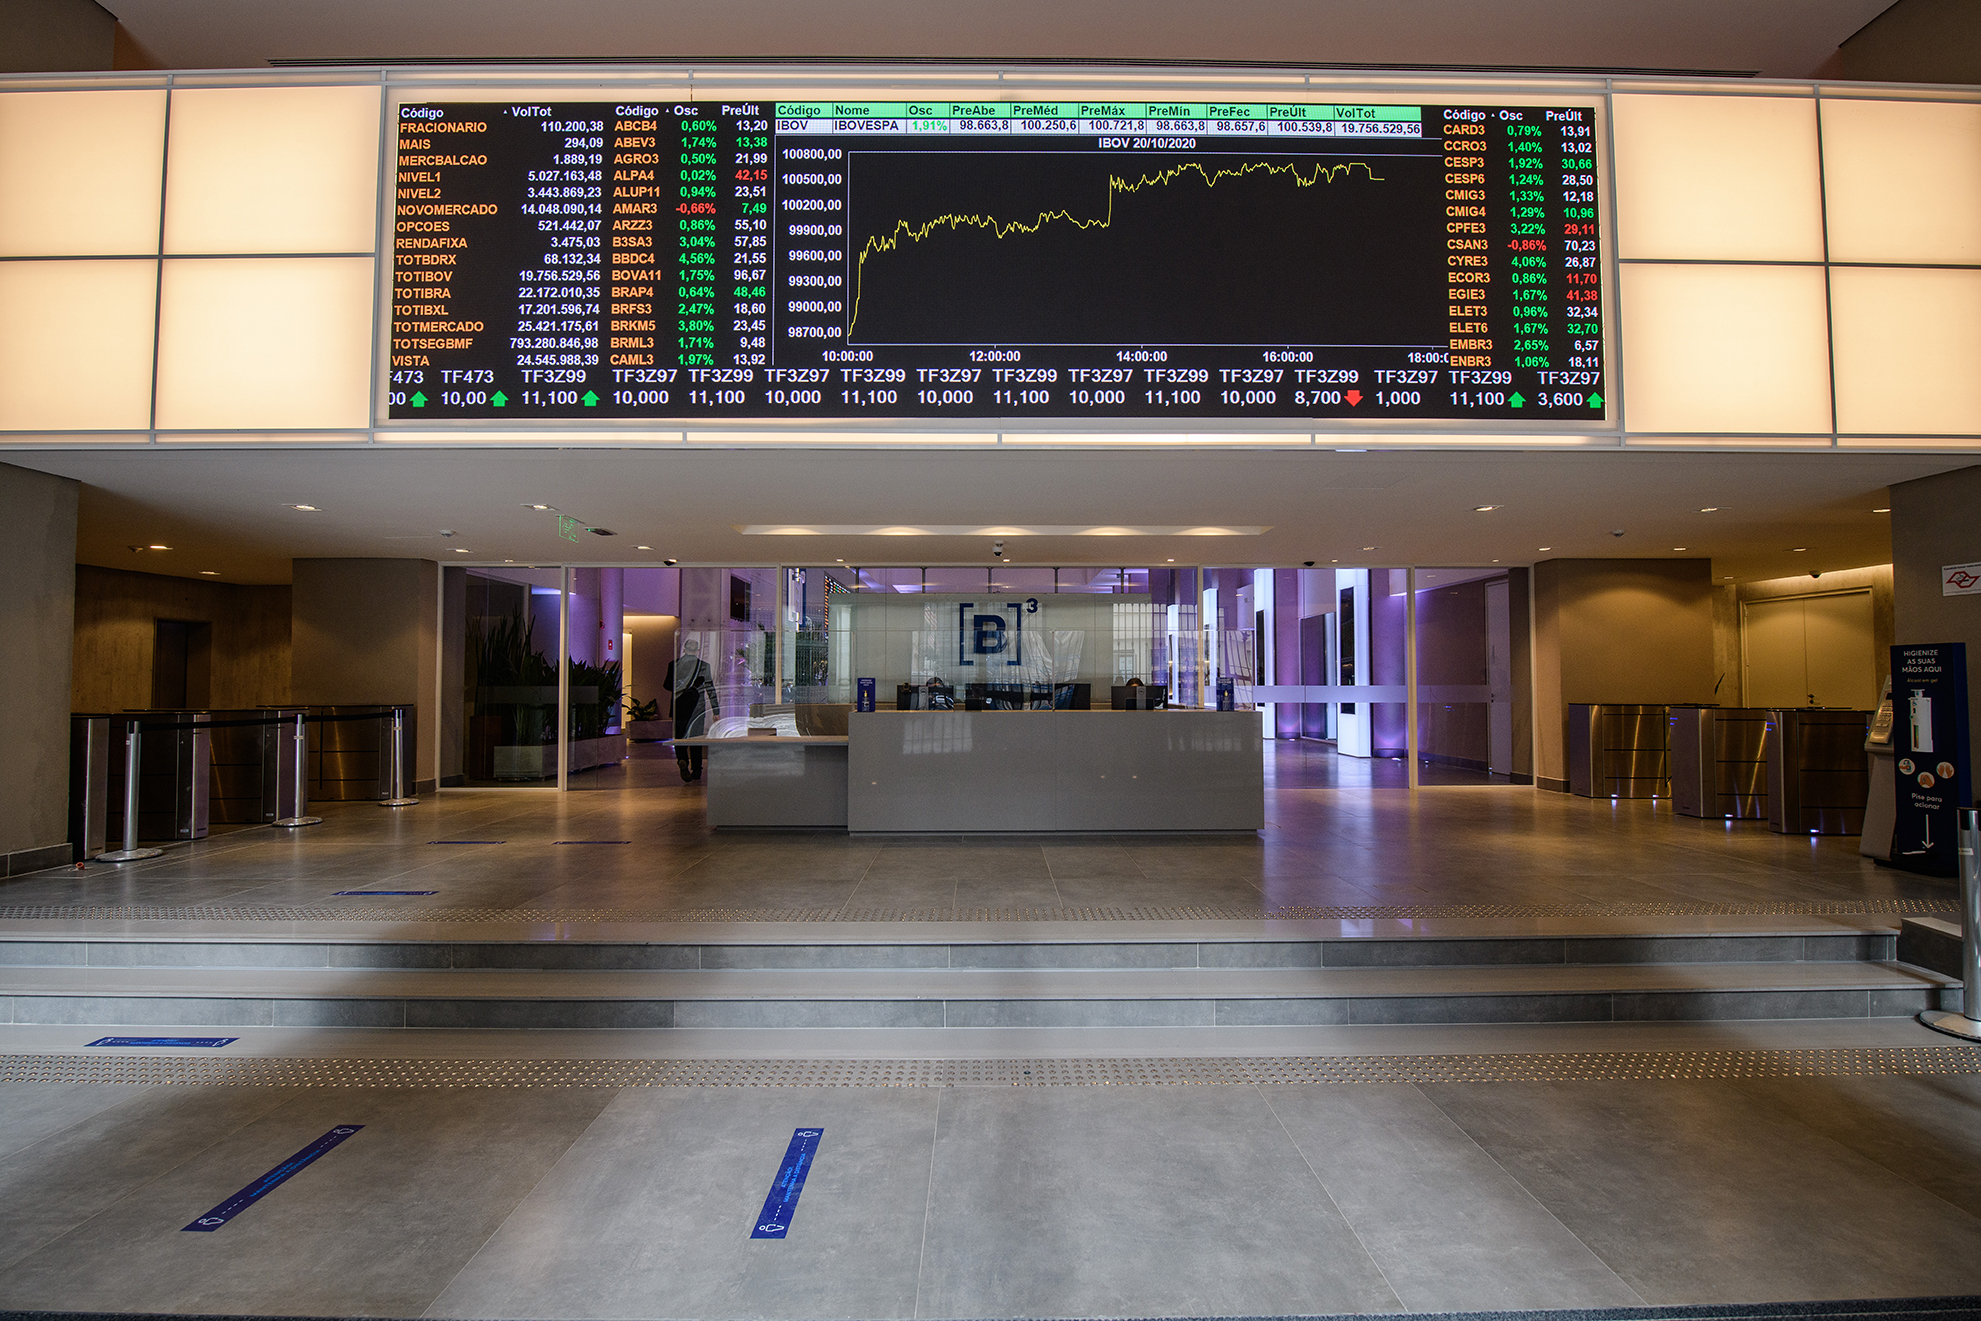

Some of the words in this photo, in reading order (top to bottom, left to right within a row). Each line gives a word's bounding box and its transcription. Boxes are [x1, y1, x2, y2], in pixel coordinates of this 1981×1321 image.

[401, 108, 443, 120] Código
[511, 106, 551, 116] VolTot
[615, 105, 658, 118] Código
[674, 105, 698, 115] Osc
[722, 102, 759, 115] PreÚlt
[777, 103, 822, 119] Código
[835, 103, 870, 116] Nome
[908, 103, 934, 116] Osc
[952, 103, 997, 116] PreAbe
[1013, 103, 1060, 117] PreMéd
[1080, 103, 1127, 117] PreMáx
[1209, 105, 1251, 119] PreFec
[1269, 104, 1308, 119] PreÚlt
[1335, 107, 1377, 120] VolTot
[1443, 109, 1486, 122] Código
[1499, 110, 1523, 120] Osc
[1546, 109, 1582, 121] PreÚlt
[400, 122, 487, 133] FRACIONARIO
[541, 121, 603, 133] 110.200,38
[615, 121, 657, 131] ABCB4
[681, 120, 717, 132] 0,60%
[736, 120, 768, 132] 13,20
[776, 119, 809, 132] IBOV
[834, 119, 899, 132] IBOVESPA
[911, 119, 948, 132] 1,91%
[959, 119, 1009, 132] 98.663,8
[1020, 119, 1077, 132] 100.250,6
[1088, 119, 1145, 133] 100.721,8
[1155, 120, 1206, 132] 98.663,8
[1216, 121, 1267, 133] 98.657,6
[1277, 121, 1333, 134] 100.539,8
[1341, 122, 1421, 136] 19.756.529,56
[1444, 124, 1485, 135] CARD3
[1507, 125, 1542, 137] 0,79%
[1560, 126, 1590, 138] 13,91
[1099, 137, 1130, 148] IBOV
[1133, 138, 1196, 148] 20/10/2020
[399, 155, 487, 166] MERCBALCAO
[553, 154, 602, 166] 1.889,19
[614, 154, 659, 164] AGRO3
[681, 153, 716, 165] 0,50%
[735, 153, 767, 165] 21,99
[782, 148, 842, 161] 100800,00
[1445, 157, 1484, 167] CESP3
[1509, 158, 1543, 169] 1,92%
[1562, 159, 1592, 170] 30,66
[782, 174, 842, 186] 100500,00
[398, 188, 441, 198] NIVEL2
[527, 187, 601, 199] 3.443.869,23
[613, 187, 660, 197] ALUP11
[680, 186, 716, 198] 0,94%
[735, 186, 766, 198] 23,51
[1446, 190, 1486, 200] CMIG3
[1510, 191, 1544, 202] 1,33%
[1563, 191, 1594, 203] 12,18
[782, 199, 842, 211] 100200,00
[397, 221, 450, 232] OPCOES
[538, 220, 601, 232] 521.442,07
[613, 220, 653, 230] ARZZ3
[680, 220, 715, 232] 0,86%
[734, 219, 767, 231] 55,10
[788, 224, 842, 237] 99900,00
[1447, 222, 1486, 233] CPFE3
[1511, 223, 1545, 235] 3,22%
[1565, 224, 1594, 236] 29,11
[396, 254, 456, 265] TOTBDRX
[544, 253, 601, 265] 68.132,34
[613, 253, 655, 264] BBDC4
[679, 253, 715, 265] 4,56%
[734, 252, 766, 265] 21,55
[788, 250, 842, 262] 99600,00
[1448, 256, 1488, 266] CYRE3
[1511, 257, 1546, 268] 4,06%
[1565, 257, 1596, 269] 26,87
[788, 275, 842, 288] 99300,00
[394, 288, 451, 299] TOTIBRA
[518, 287, 600, 299] 22.172.010,35
[612, 287, 654, 297] BRAP4
[679, 287, 715, 299] 0,64%
[734, 286, 766, 298] 48,46
[1449, 289, 1485, 299] EGIE3
[1513, 290, 1547, 301] 1,67%
[1567, 290, 1598, 302] 41,38
[788, 301, 842, 313] 99000,00
[394, 321, 484, 332] TOTMERCADO
[517, 320, 598, 333] 25.421.175,61
[611, 320, 656, 331] BRKM5
[678, 320, 714, 332] 3,80%
[733, 320, 766, 332] 23,45
[788, 326, 842, 339] 98700,00
[1450, 322, 1488, 333] ELET6
[1514, 323, 1548, 335] 1,67%
[1568, 324, 1598, 335] 32,70
[392, 355, 430, 366] VISTA
[516, 354, 599, 366] 24.545.988,39
[610, 354, 654, 365] CAML3
[678, 354, 714, 366] 1,97%
[733, 354, 765, 366] 13,92
[822, 350, 873, 361] 10:00:00
[969, 350, 1021, 361] 12:00:00
[1116, 350, 1167, 361] 14:00:00
[1263, 351, 1313, 362] 16:00:00
[1451, 356, 1492, 366] ENBR3
[1515, 356, 1549, 368] 1,06%
[1568, 357, 1598, 368] 18,11
[440, 370, 494, 383] TF473
[521, 369, 586, 383] TF3Z99
[612, 369, 677, 382] TF3Z97
[688, 369, 753, 382] TF3Z99
[764, 369, 830, 382] TF3Z97
[840, 368, 906, 382] TF3Z99
[916, 368, 981, 382] TF3Z97
[992, 368, 1057, 382] TF3Z99
[1068, 369, 1133, 382] TF3Z97
[1144, 369, 1208, 382] TF3Z99
[1219, 369, 1284, 382] TF3Z97
[1294, 369, 1359, 383] TF3Z99
[1374, 370, 1438, 383] TF3Z97
[1448, 371, 1512, 384] TF3Z99
[1537, 371, 1600, 384] TF3Z97
[441, 391, 486, 407] 10,00
[522, 391, 577, 406] 11,100
[613, 390, 669, 406] 10,000
[689, 390, 745, 406] 11,100
[765, 390, 821, 406] 10,000
[841, 390, 897, 406] 11,100
[918, 390, 973, 406] 10,000
[993, 390, 1049, 406] 11,100
[1069, 390, 1125, 406] 10,000
[1145, 390, 1200, 406] 11,100
[1221, 390, 1276, 406] 10,000
[1295, 391, 1341, 406] 8,700
[1376, 391, 1420, 407] 1,000
[1450, 392, 1504, 407] 11,100
[1538, 392, 1583, 408] 3,600
